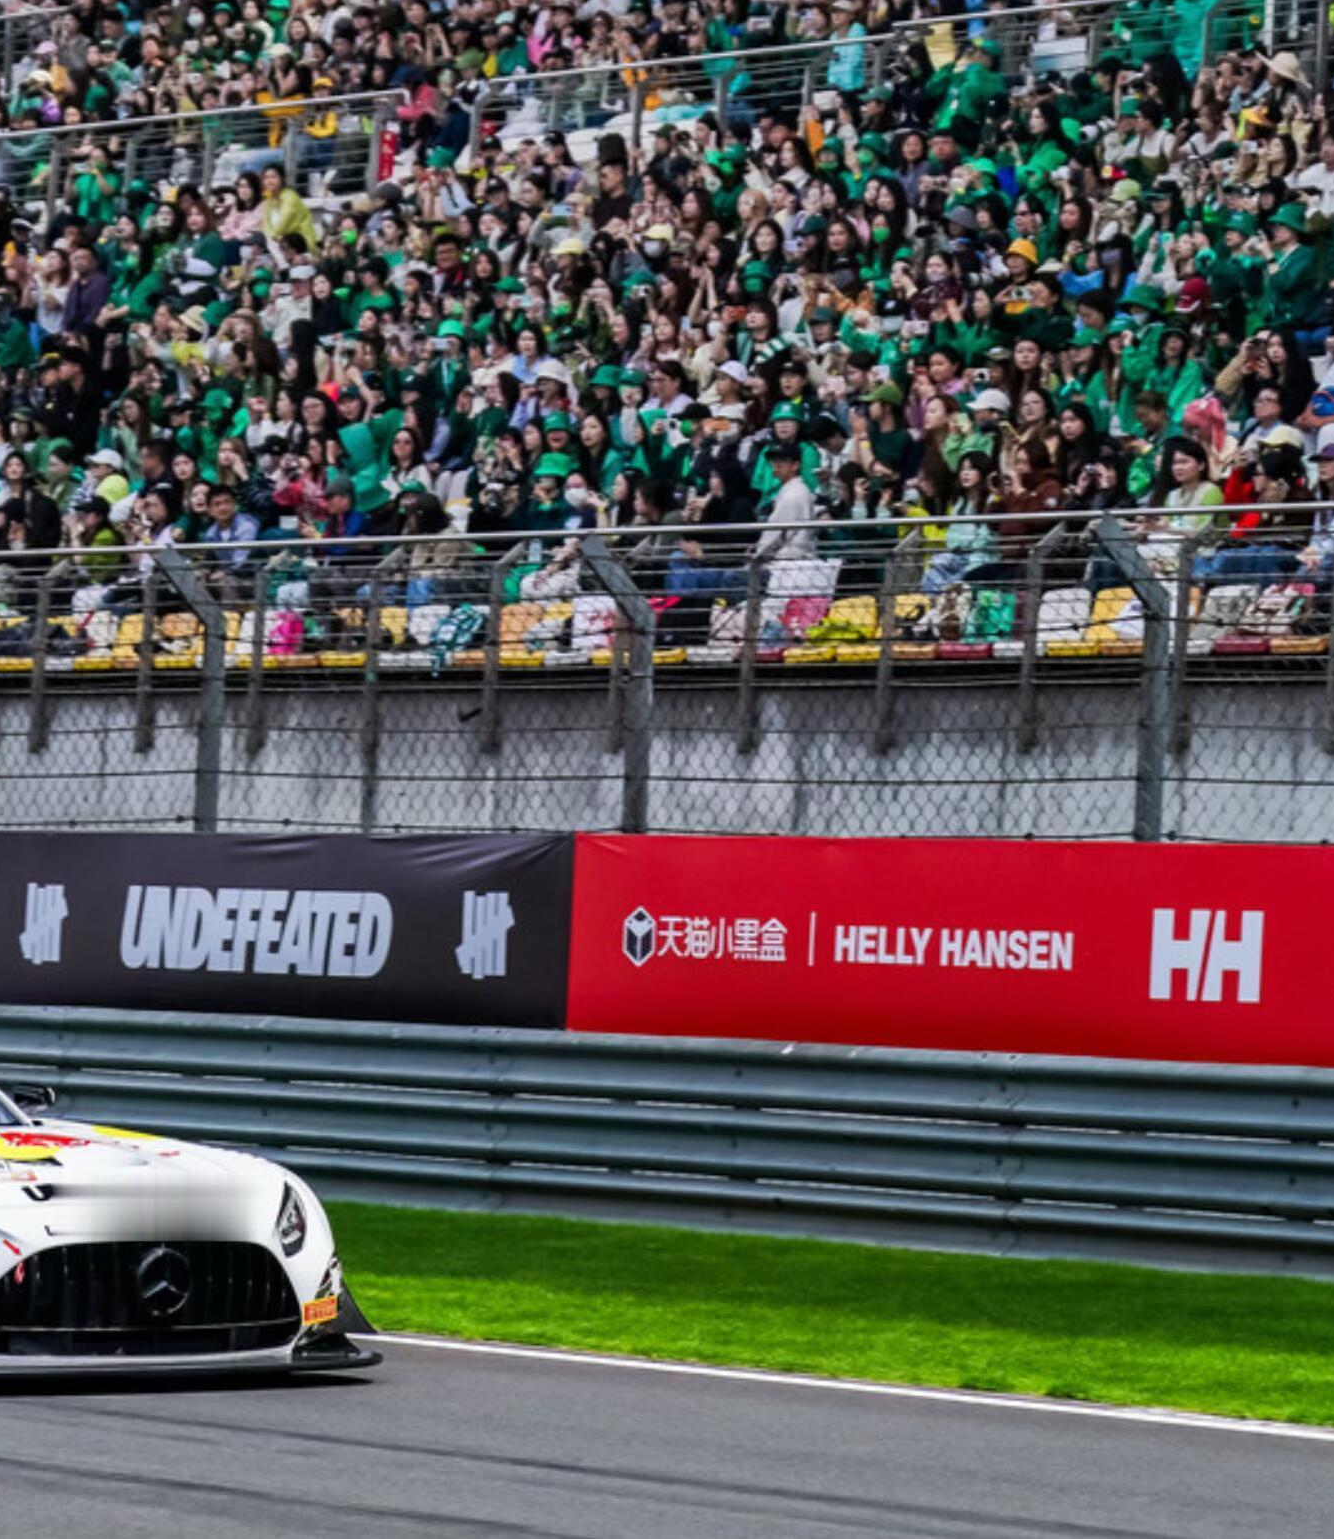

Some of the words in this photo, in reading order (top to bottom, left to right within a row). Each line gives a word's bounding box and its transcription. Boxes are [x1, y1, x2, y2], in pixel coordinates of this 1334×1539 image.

[121, 884, 393, 977] UNDEFEATED
[659, 915, 787, 963] 天猫小黑盒
[834, 924, 930, 966] HELLY
[940, 928, 1073, 971] HANSEN
